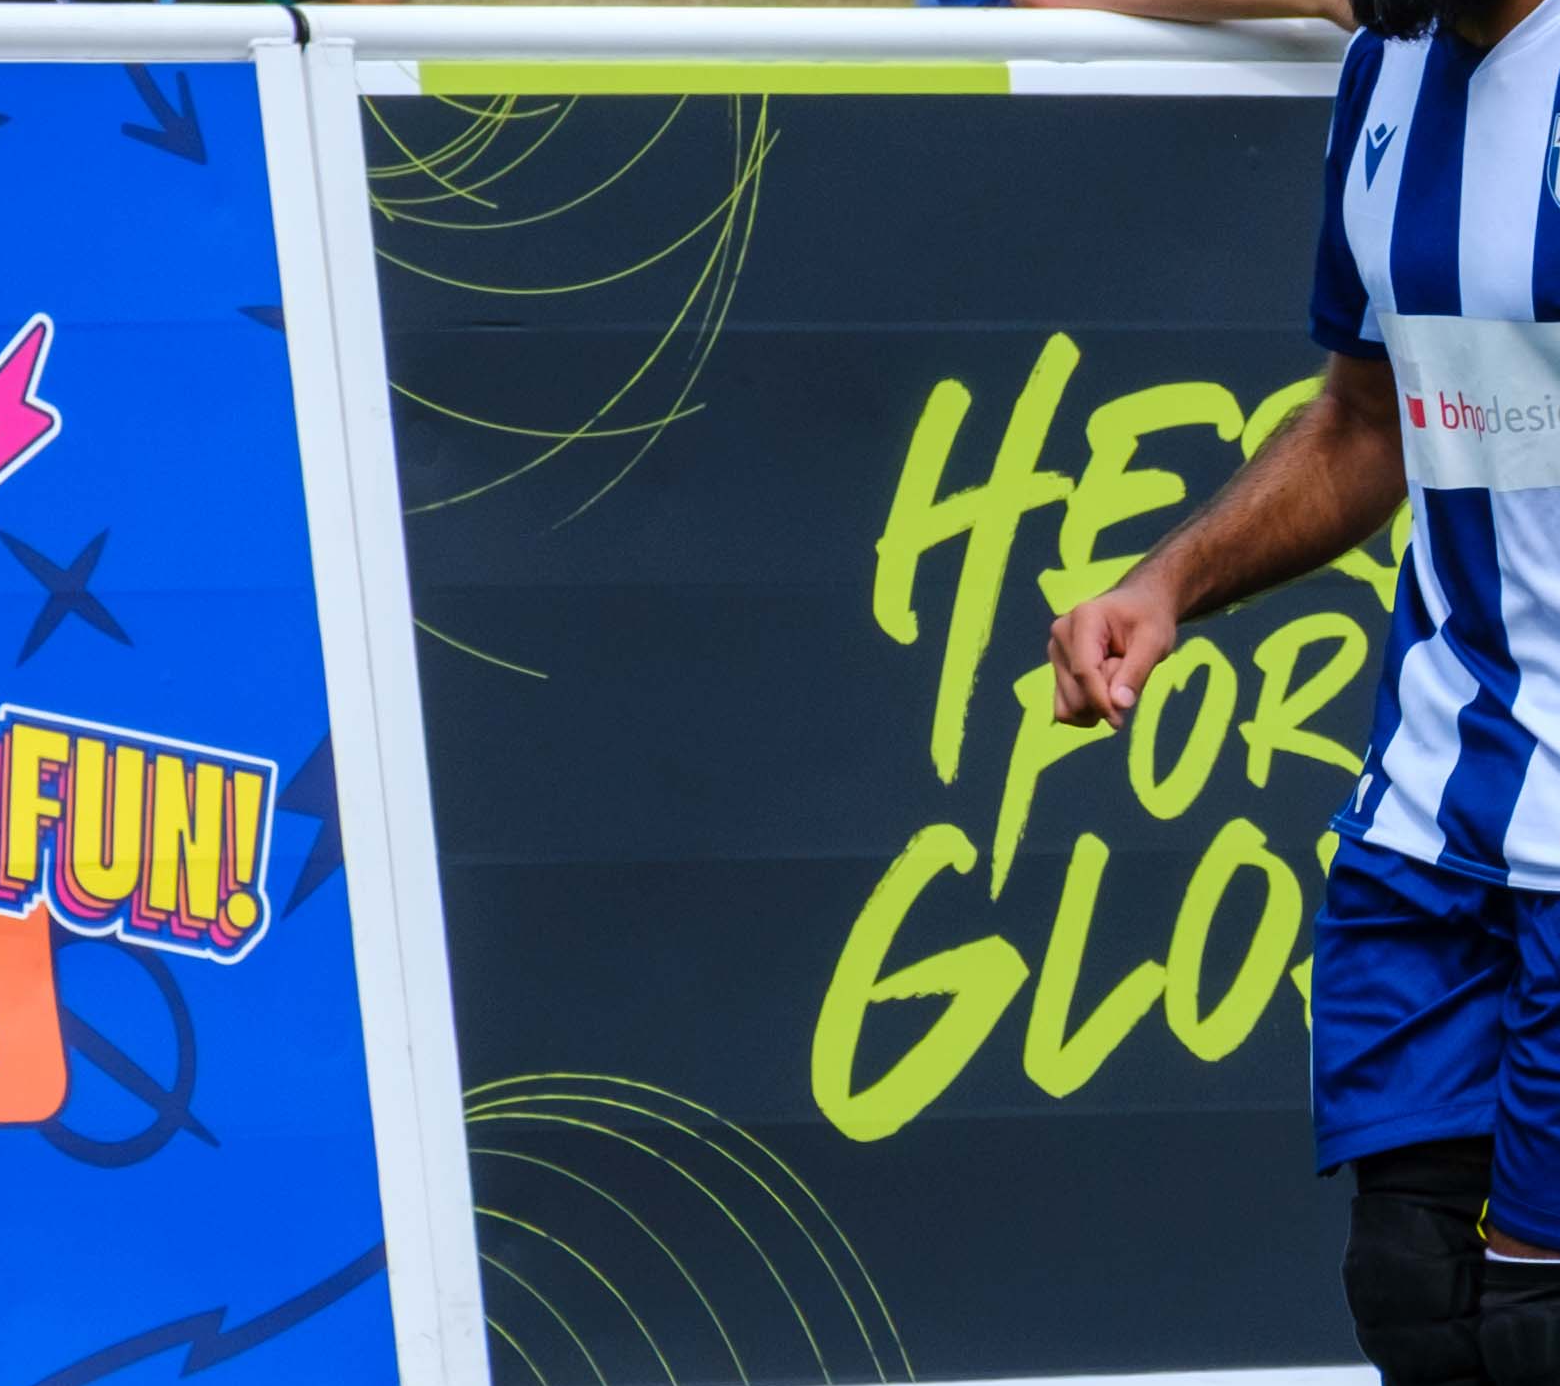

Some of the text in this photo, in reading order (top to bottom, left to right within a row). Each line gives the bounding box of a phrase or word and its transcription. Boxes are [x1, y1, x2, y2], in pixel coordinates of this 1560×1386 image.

[874, 332, 1411, 784] HE
[0, 719, 264, 937] FUN!
[991, 612, 1369, 901] FOR
[811, 817, 1338, 1143] GLO
